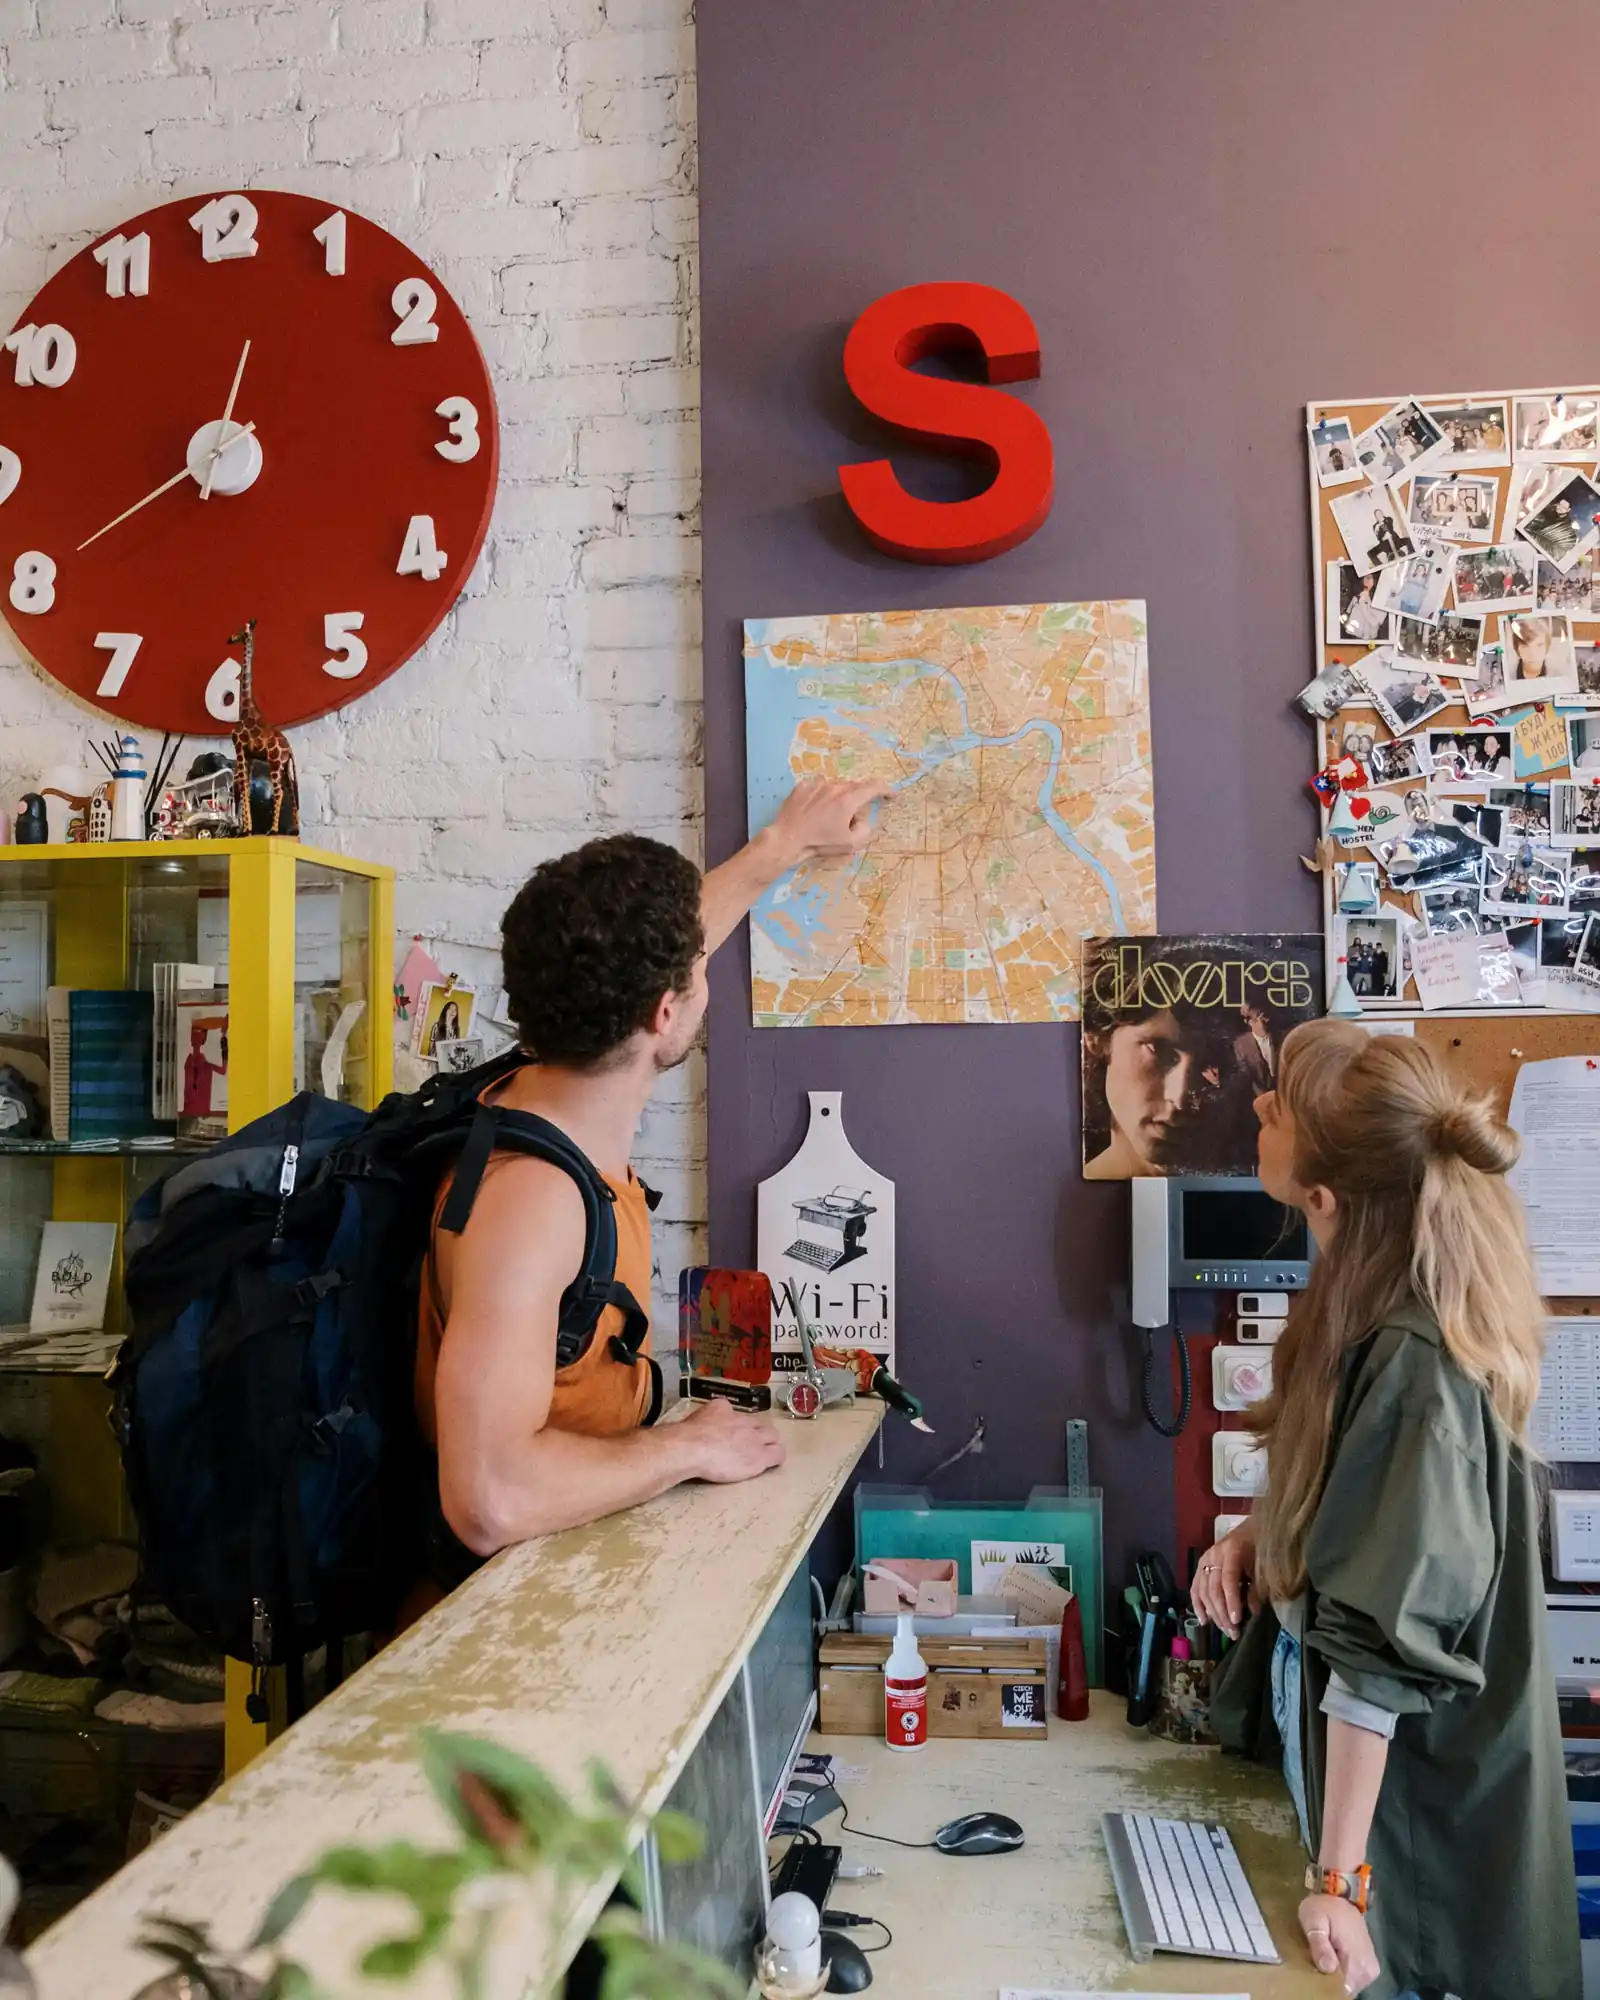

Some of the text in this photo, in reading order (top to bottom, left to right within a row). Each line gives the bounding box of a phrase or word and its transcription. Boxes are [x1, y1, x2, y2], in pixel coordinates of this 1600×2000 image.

[189, 195, 259, 263] 12
[313, 210, 346, 276] 1
[93, 232, 150, 298] 11
[391, 278, 439, 345] 2
[3, 323, 76, 387] 10
[435, 396, 480, 463] 3
[838, 282, 1054, 564] S
[396, 515, 447, 580] 4
[10, 551, 56, 615] 8
[94, 632, 143, 697] 7
[321, 611, 368, 679] 5
[205, 657, 241, 722] 6
[1546, 741, 1565, 760] 100
[1342, 834, 1375, 845] HOSTEL
[771, 1281, 888, 1319] Wi-Fi
[1014, 1692, 1033, 1703] ME
[1014, 1704, 1033, 1712] OUT
